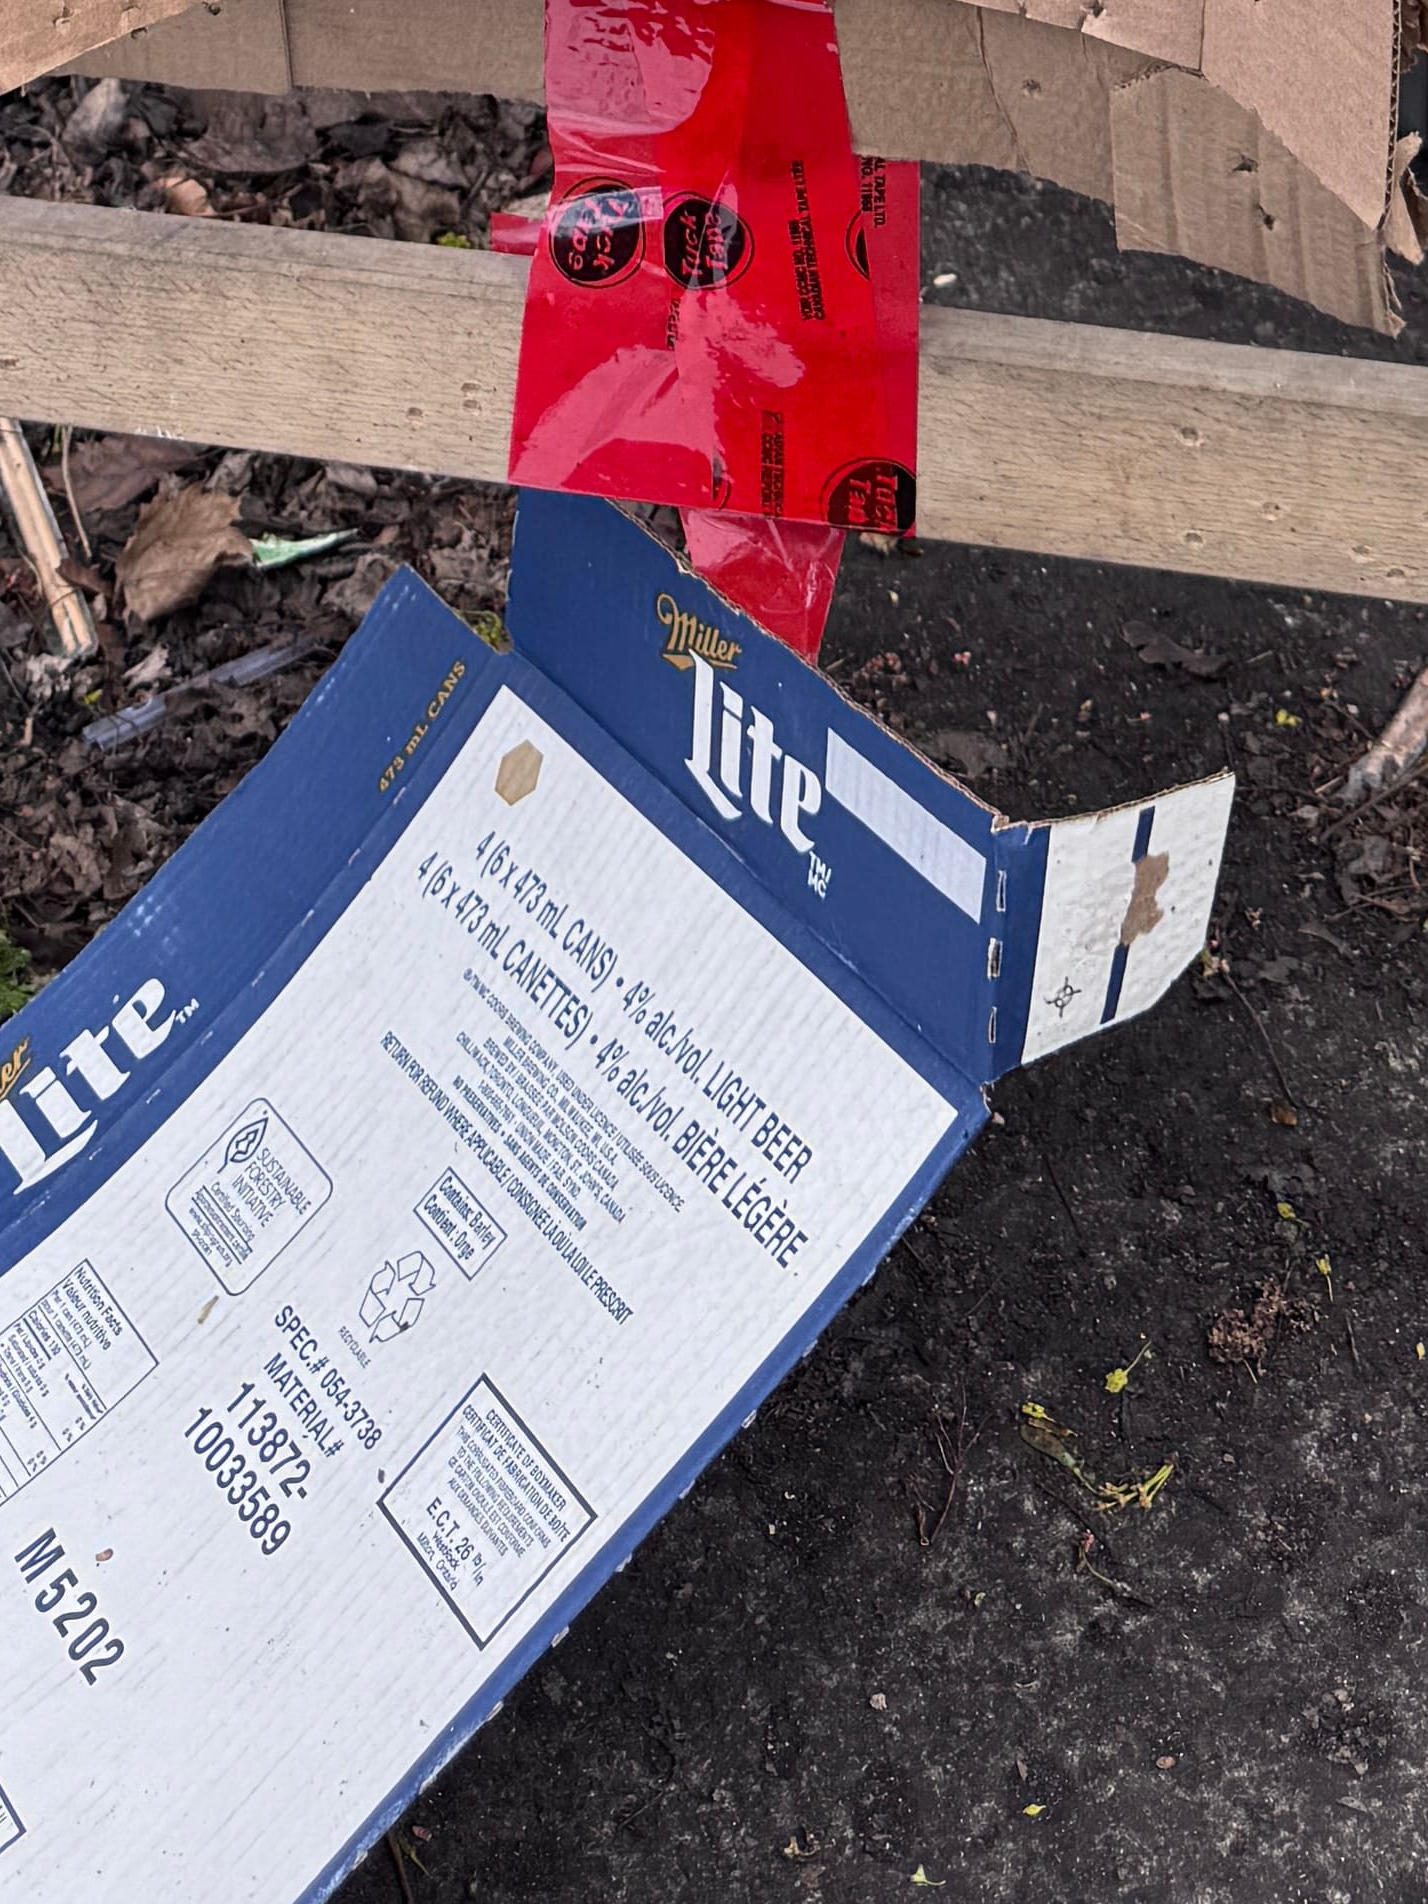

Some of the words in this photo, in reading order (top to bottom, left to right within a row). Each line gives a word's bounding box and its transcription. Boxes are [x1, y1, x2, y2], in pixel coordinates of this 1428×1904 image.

[795, 187, 809, 213] TAPE
[873, 175, 885, 203] TAPE
[873, 204, 885, 228] LTD.
[679, 209, 703, 276] Tuck
[801, 218, 816, 268] TECHNICAL
[808, 270, 824, 319] CANADIAN
[657, 594, 742, 670] Miller
[379, 756, 404, 791] 473
[405, 724, 428, 754] mL
[427, 661, 465, 718] CANS
[684, 649, 821, 853] Lite
[417, 851, 438, 880] 4
[475, 830, 496, 860] 4
[479, 839, 510, 878] (6
[421, 860, 453, 898] (6
[440, 881, 460, 909] x
[498, 861, 519, 889] x
[512, 868, 547, 913] 473
[454, 889, 489, 934] 473
[535, 898, 569, 939] mL
[477, 919, 510, 960] mL
[562, 918, 618, 993] CANS)
[502, 938, 593, 1051] CANETTES)
[622, 980, 656, 1024] 4%
[379, 1030, 412, 1069] RETURN
[404, 1058, 424, 1083] FOR
[595, 1037, 630, 1082] 4%
[644, 1010, 713, 1084] alc./vol.
[417, 1073, 450, 1111] REFUND
[482, 1036, 509, 1067] BREWED
[504, 1060, 517, 1075] BY
[539, 1099, 556, 1119] PAR
[550, 1112, 578, 1144] MOLSON
[573, 1138, 597, 1166] COORS
[591, 1159, 619, 1192] CANADA
[486, 993, 509, 1020] COORS
[504, 1012, 532, 1046] BREWING
[527, 1039, 558, 1077] COMPANY,
[555, 1069, 575, 1092] USED
[570, 1085, 594, 1113] UNDER
[589, 1105, 618, 1138] LICENCE
[615, 1134, 644, 1167] UTILISÉE
[638, 1160, 660, 1184] SOUS
[502, 1035, 526, 1063] MILLER
[520, 1055, 550, 1089] BREWING
[557, 1095, 594, 1139] MILWAUKEE,
[616, 1068, 684, 1142] alc./vol.
[702, 1062, 767, 1132] LIGHT
[442, 1102, 473, 1139] WHERE
[514, 1121, 536, 1147] UNION
[530, 1139, 551, 1165] MADE
[750, 1111, 812, 1184] BEER
[452, 1074, 464, 1090] NO
[459, 1083, 502, 1134] PRESERVATIVES
[502, 1133, 522, 1156] SANS
[517, 1150, 542, 1178] AGENTS
[536, 1172, 550, 1188] DE
[545, 1181, 587, 1231] CONSERVATION
[463, 1129, 511, 1183] APPLICABLE
[671, 1119, 738, 1194] BIÈRE
[231, 1173, 274, 1228] INITIATIVE
[243, 1160, 286, 1210] FORESTRY
[256, 1147, 312, 1215] SUSTAINABLE
[506, 1176, 551, 1230] CONSIGNÉE
[599, 1192, 626, 1224] CANADA
[230, 1207, 255, 1243] Sourcing
[417, 1193, 457, 1237] Contient
[449, 1230, 475, 1260] Orge
[438, 1175, 474, 1222] Contains:
[468, 1210, 496, 1250] Barley
[538, 1218, 558, 1241] LÀ
[720, 1172, 809, 1268] LÉGÈRE
[550, 1230, 573, 1251] OÙ
[560, 1241, 582, 1263] LA
[569, 1251, 592, 1276] LOI
[73, 1266, 105, 1311] Nutrition
[100, 1305, 122, 1336] Facts
[580, 1264, 598, 1286] LE
[589, 1275, 634, 1325] PRESCRIT
[61, 1278, 86, 1312] Valeur
[81, 1309, 111, 1350] nutritive
[338, 1325, 371, 1369] RECYCLABLE
[274, 1304, 330, 1374] SPEC.#
[319, 1367, 382, 1450] 054-3738
[263, 1351, 344, 1458] MATERIAL#
[226, 1382, 311, 1499] 113872-
[485, 1408, 526, 1459] CERTIFICATE
[520, 1453, 535, 1468] OF
[529, 1464, 566, 1512] BOXMAKER
[184, 1407, 291, 1555] 10033589
[447, 1477, 461, 1493] AUX
[456, 1424, 471, 1444] THIS
[466, 1439, 499, 1481] CORRUGATED
[522, 1512, 551, 1549] CONFORMS
[456, 1445, 467, 1459] TO
[462, 1453, 476, 1471] THE
[470, 1465, 500, 1504] FOLLOWING
[496, 1498, 534, 1547] REQUIREMENTS
[462, 1403, 499, 1449] CERTIFICAT
[492, 1444, 507, 1461] DE
[501, 1454, 544, 1509] FABRICATION
[538, 1502, 553, 1520] DE
[547, 1514, 571, 1542] BOÎTE
[425, 1496, 460, 1543] E.C.T.
[454, 1536, 475, 1560] 26
[447, 1455, 458, 1468] CE
[453, 1463, 475, 1491] CARTON
[488, 1509, 502, 1525] EST
[496, 1521, 526, 1558] CONFORME
